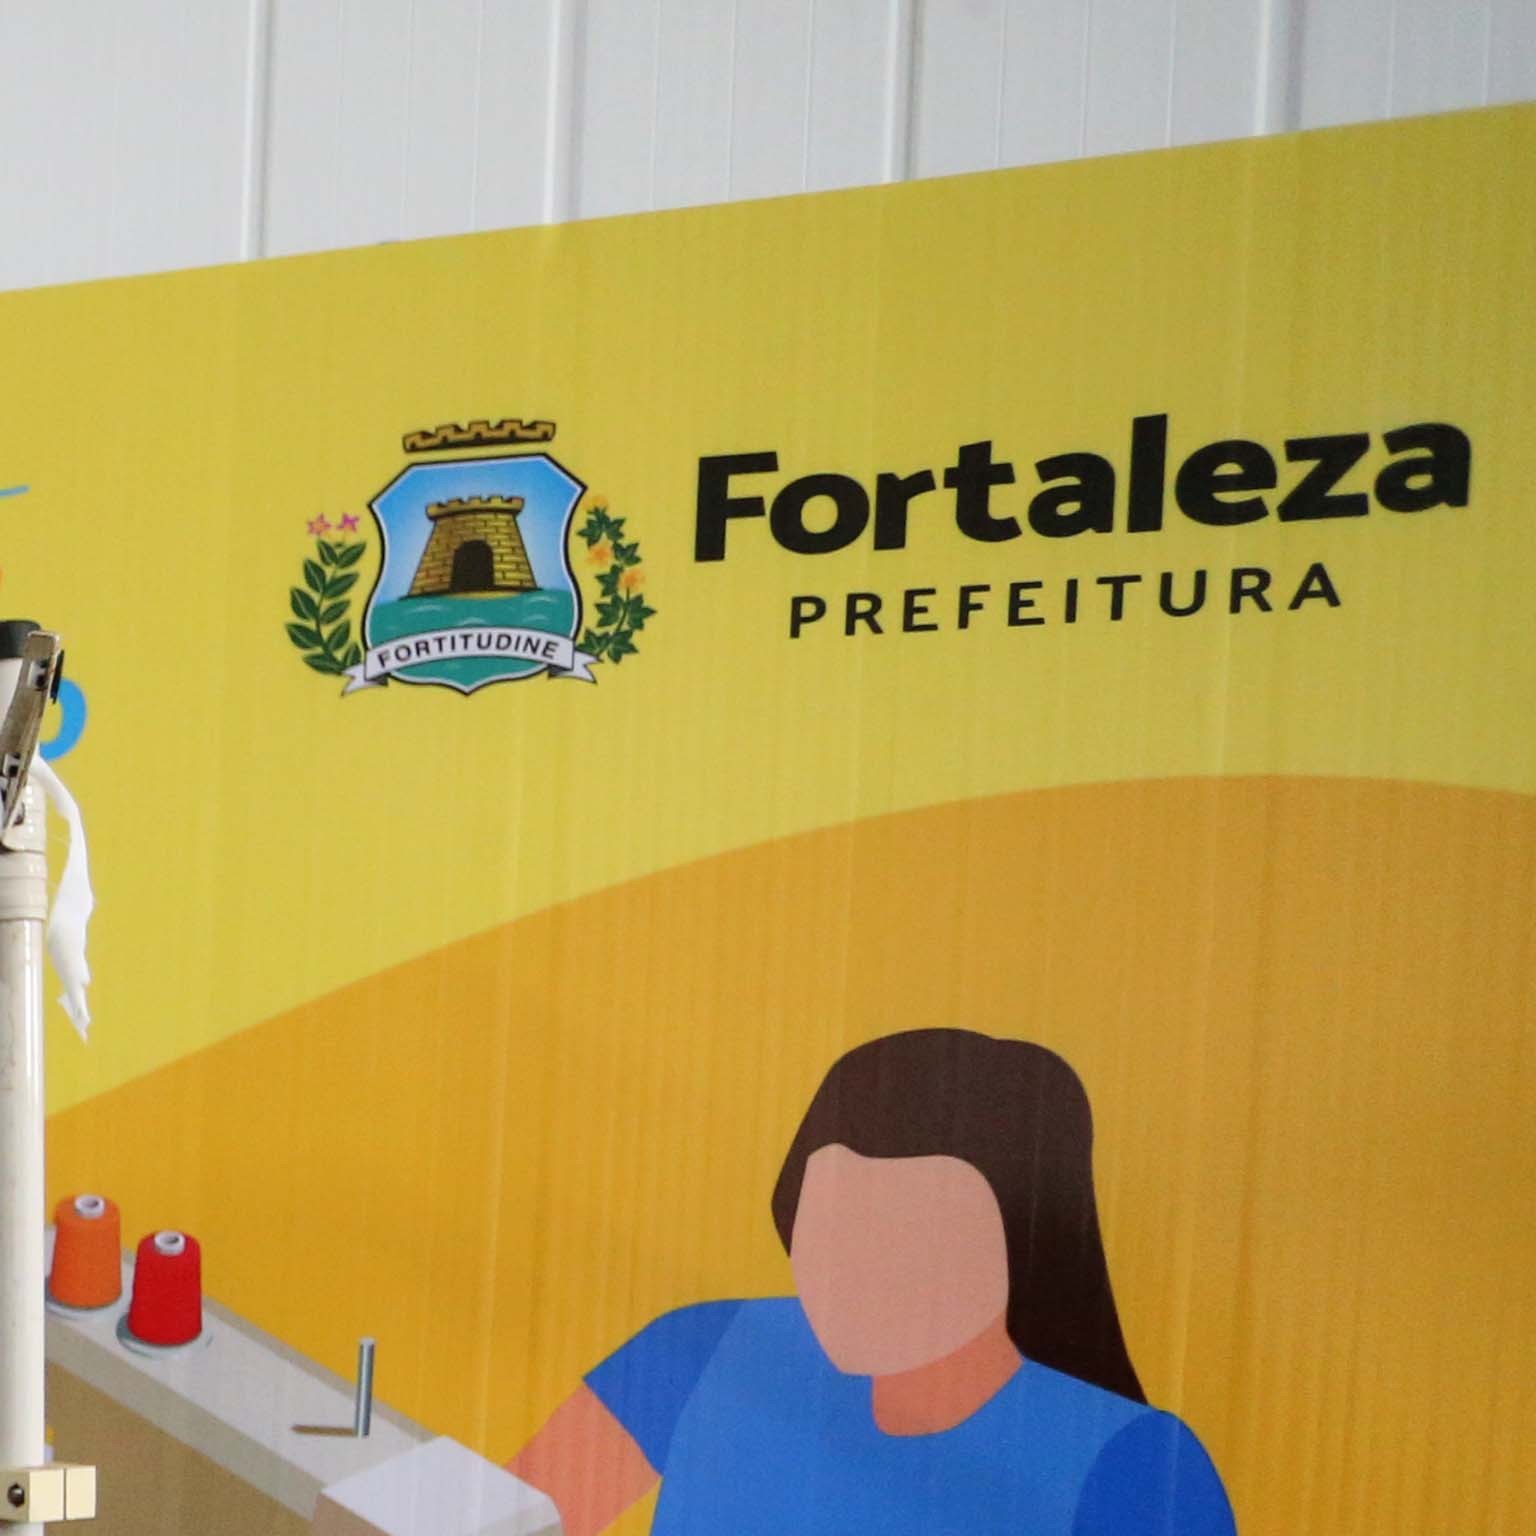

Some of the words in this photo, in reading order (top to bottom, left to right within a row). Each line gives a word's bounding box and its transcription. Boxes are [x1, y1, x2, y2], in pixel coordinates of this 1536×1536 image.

[693, 412, 1473, 563] Fortaleza
[789, 561, 1342, 639] PREFEITURA
[377, 631, 561, 669] FORTITUDINE
